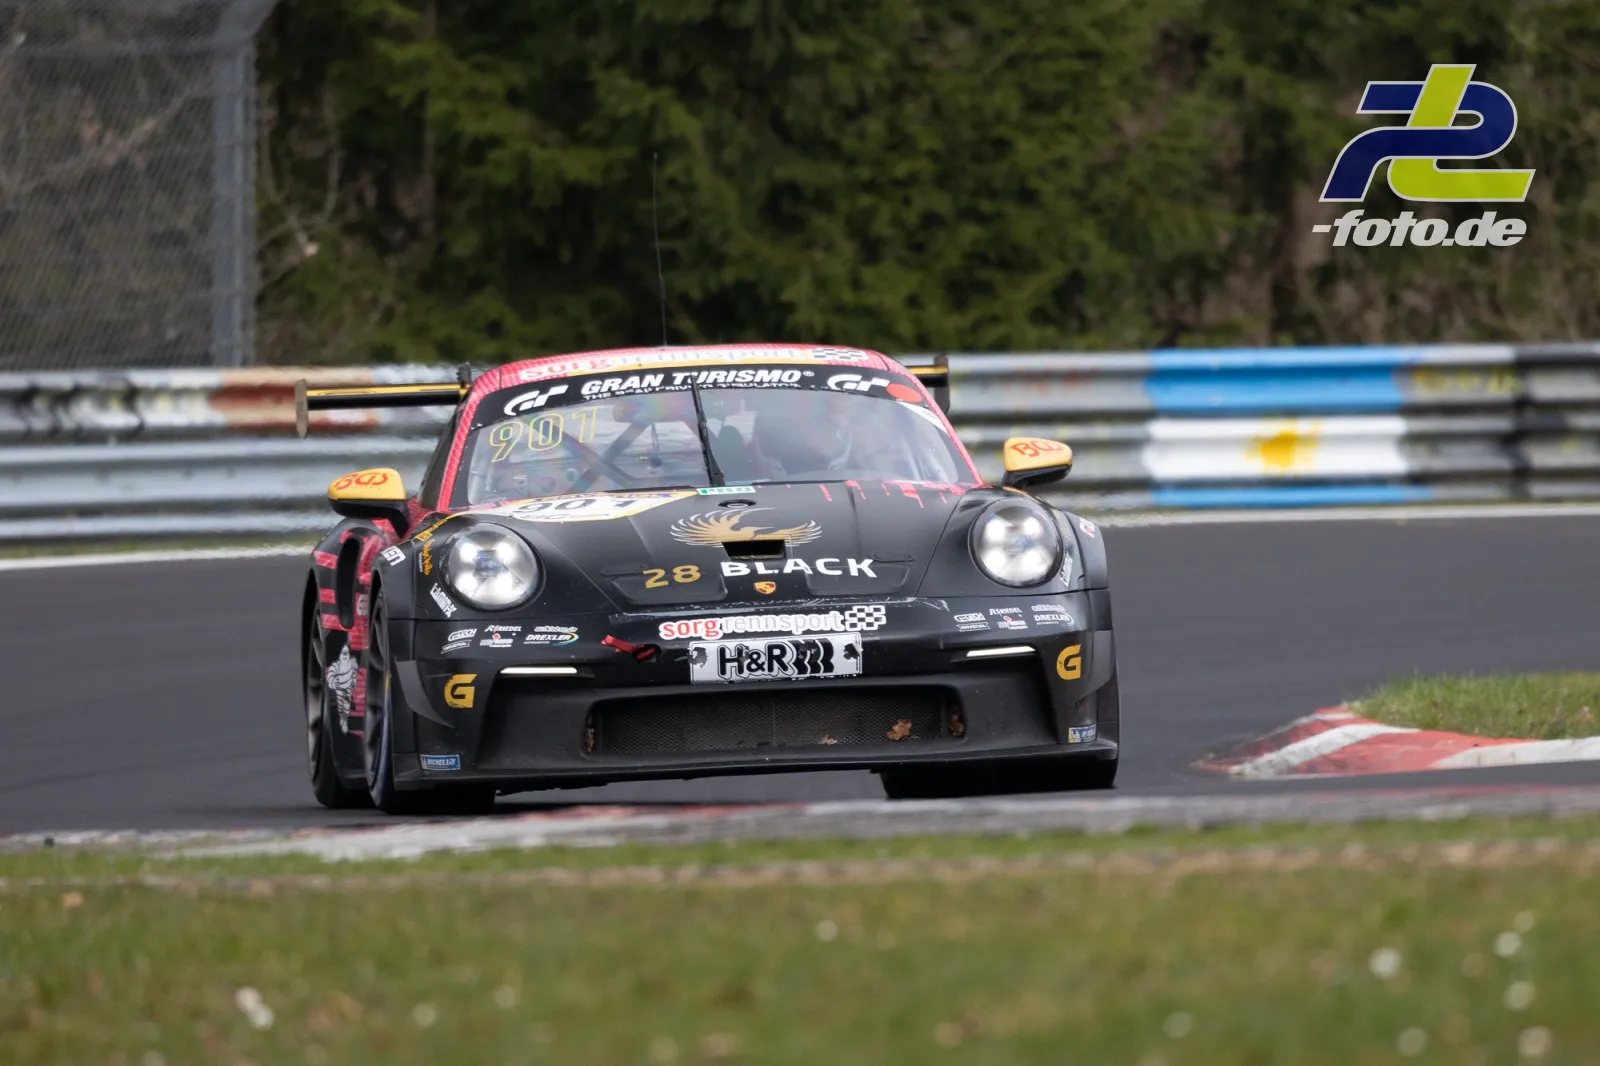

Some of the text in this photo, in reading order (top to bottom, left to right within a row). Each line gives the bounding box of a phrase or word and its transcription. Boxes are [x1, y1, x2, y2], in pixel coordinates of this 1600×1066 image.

[580, 372, 664, 395] GRAN
[489, 406, 598, 463] 901
[643, 565, 701, 590] 28
[720, 558, 877, 578] BLACK
[659, 611, 846, 641] sorgrennsport
[719, 641, 789, 677] H&R
[1056, 644, 1082, 680] G
[443, 673, 478, 708] G
